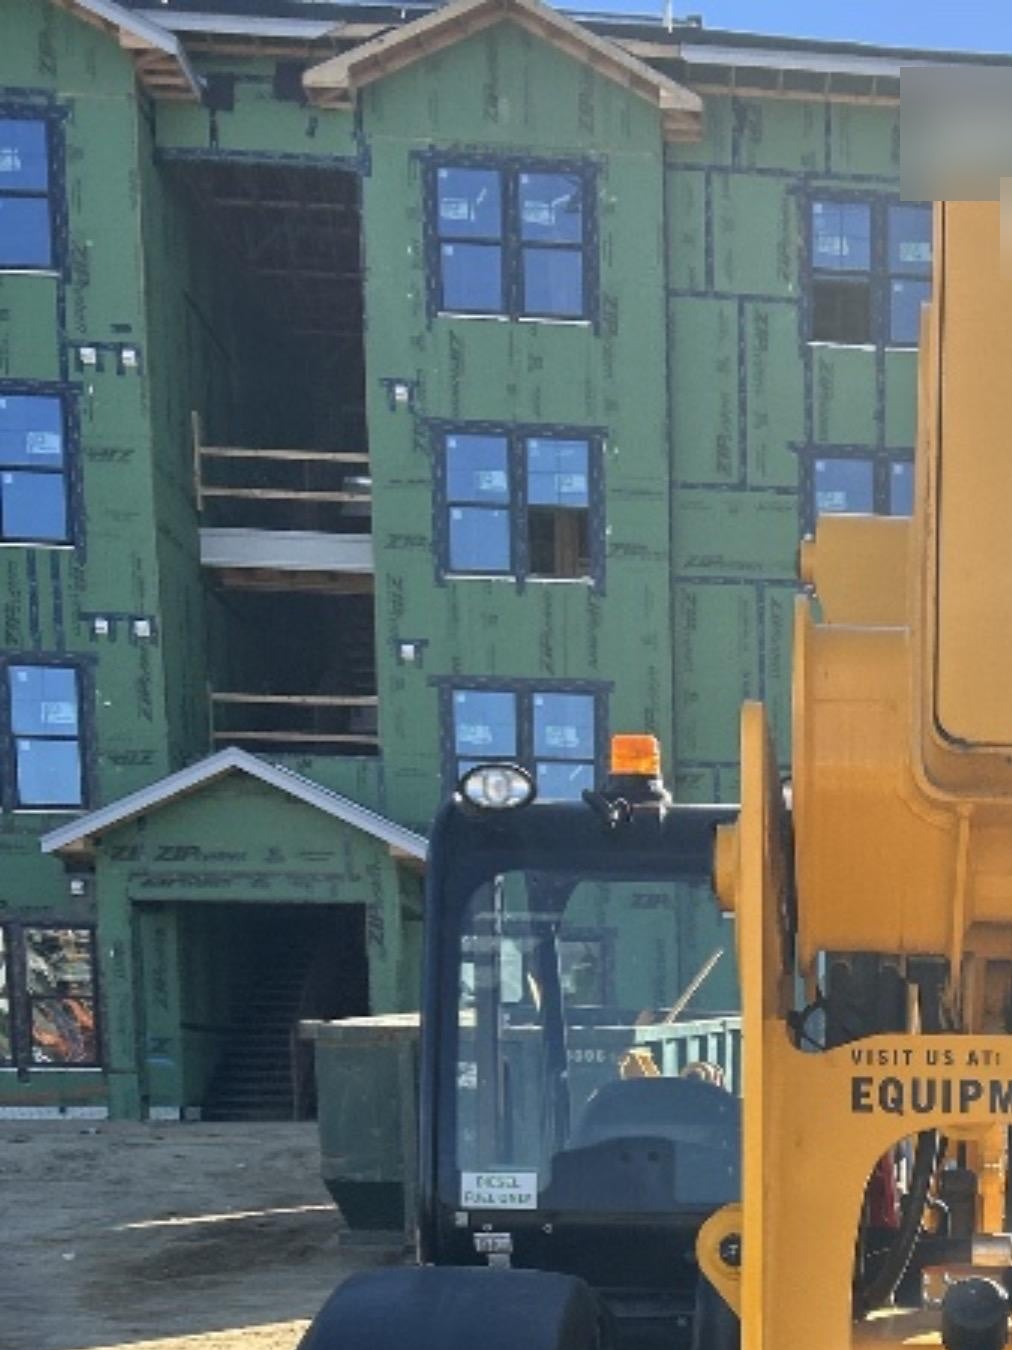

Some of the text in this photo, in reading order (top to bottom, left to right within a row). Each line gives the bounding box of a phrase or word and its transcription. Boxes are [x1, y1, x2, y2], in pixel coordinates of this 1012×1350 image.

[852, 1050, 1001, 1066] VISIT US AT:
